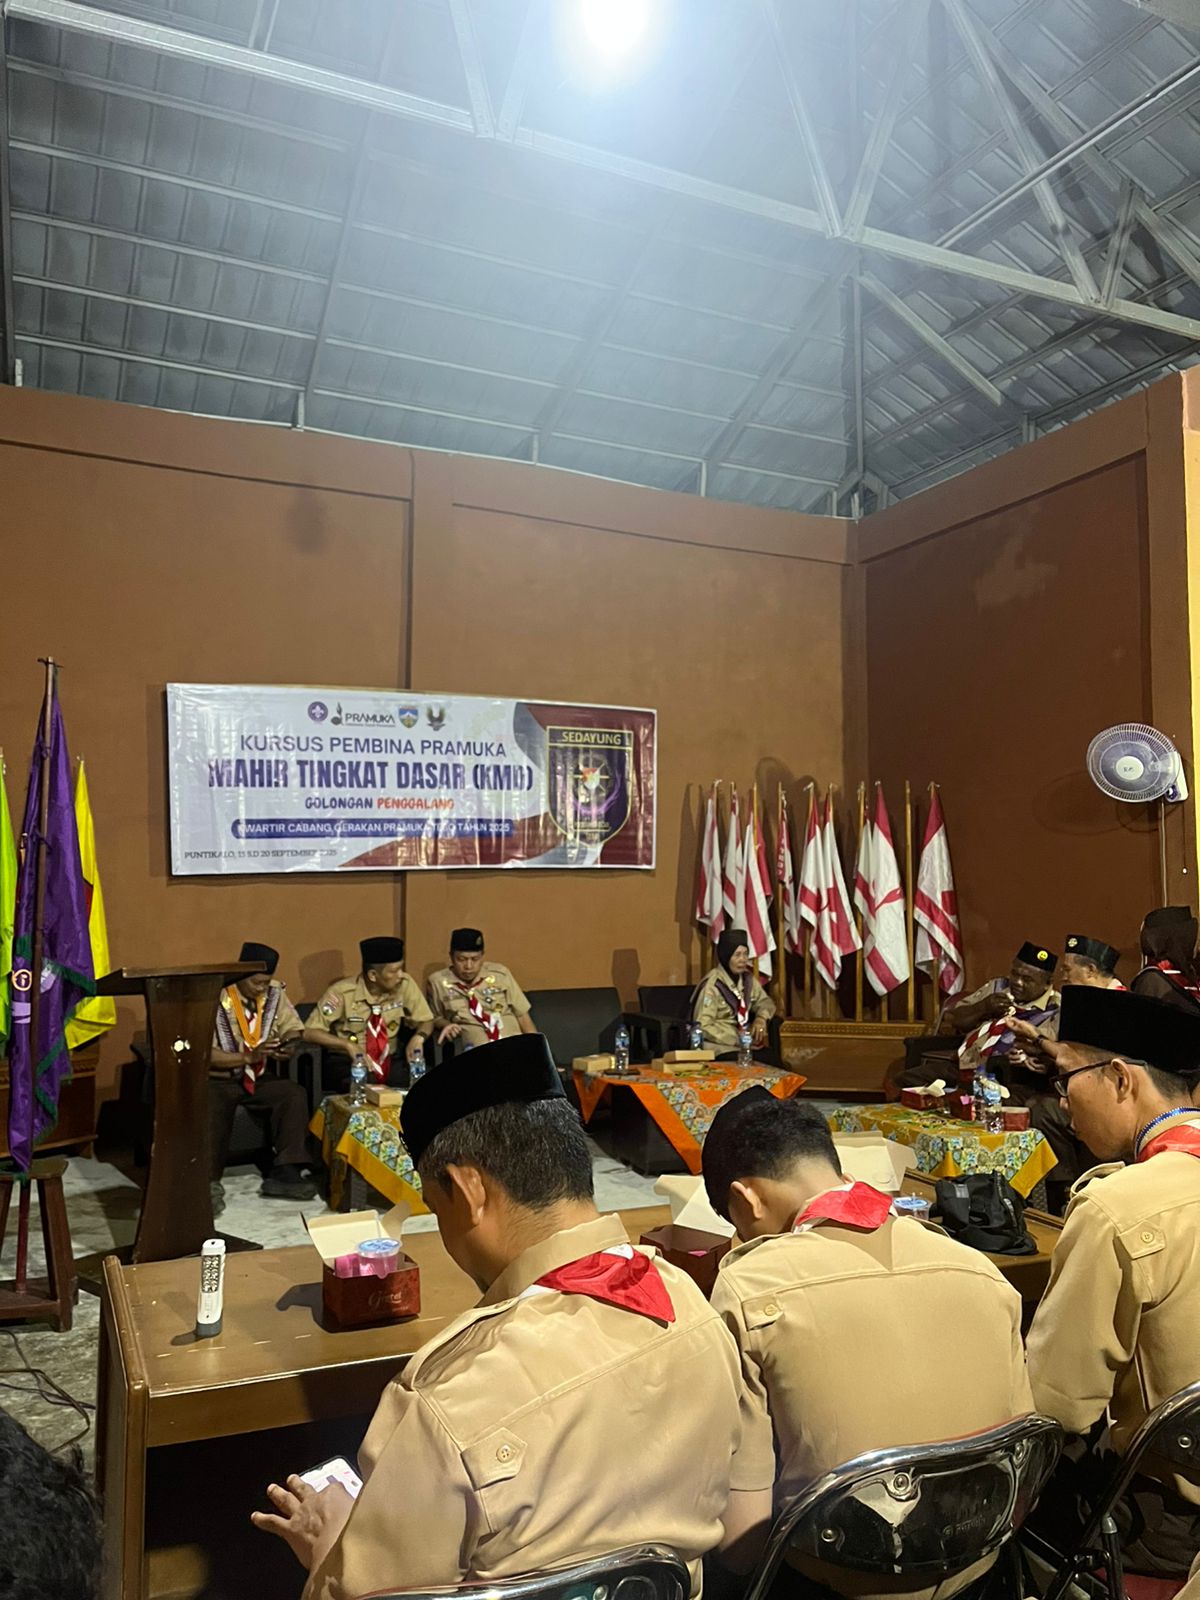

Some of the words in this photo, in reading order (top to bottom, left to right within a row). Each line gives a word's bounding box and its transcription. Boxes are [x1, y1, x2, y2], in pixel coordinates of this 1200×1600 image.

[345, 712, 395, 724] PRAMUKA
[562, 731, 621, 745] SEDAYUNG
[241, 735, 323, 752] KURSUS
[330, 737, 415, 755] PEMBINA
[421, 739, 507, 758] PRAMUKA
[208, 758, 288, 788] MAHIR
[296, 759, 388, 789] TINGKAT
[396, 761, 465, 790] DASAR
[472, 763, 533, 791] (KMD)
[305, 797, 373, 809] GOLONGAN
[377, 797, 454, 810] PENGGALANG
[334, 822, 381, 832] GERAKAN
[432, 822, 456, 831] TEO
[458, 822, 487, 832] TAHUN
